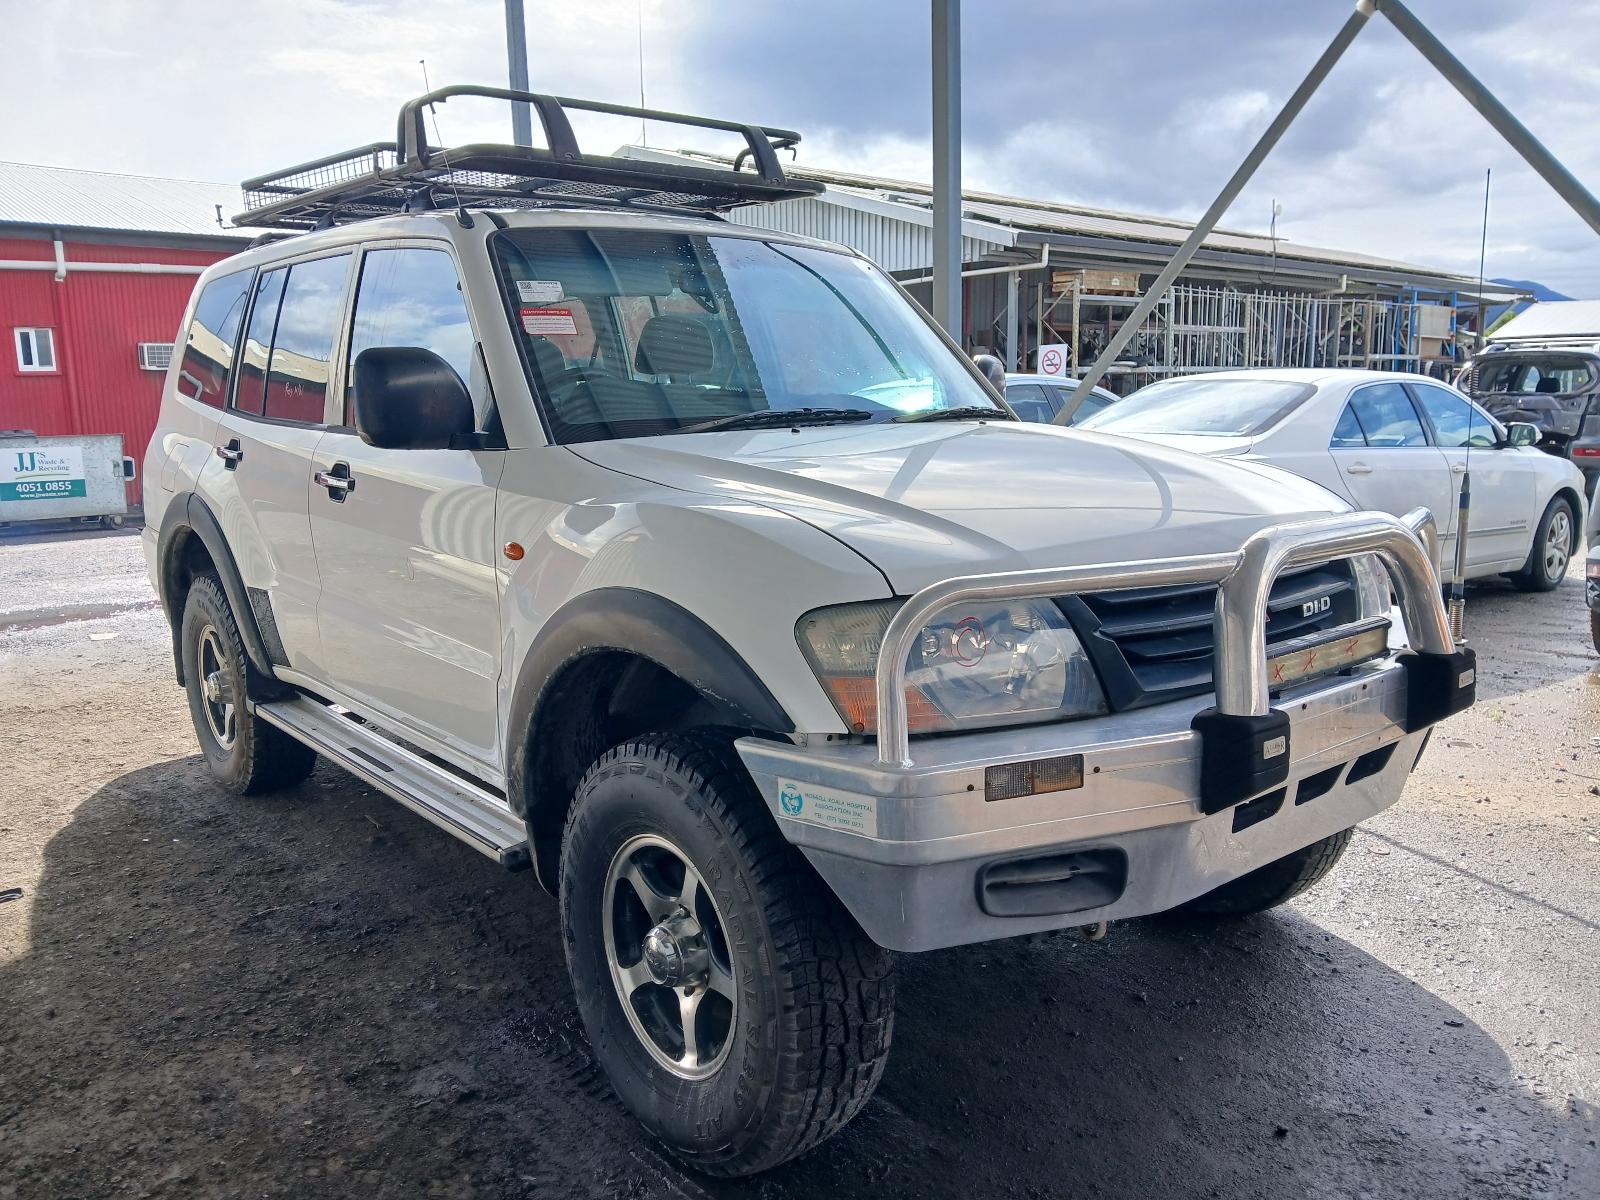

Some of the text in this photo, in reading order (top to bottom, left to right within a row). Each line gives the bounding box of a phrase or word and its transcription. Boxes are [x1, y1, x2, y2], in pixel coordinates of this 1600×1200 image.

[16, 481, 72, 492] 4051 0855
[814, 802, 849, 815] ASSOCIATION
[828, 796, 845, 805] KOALA
[846, 800, 873, 813] HOSPITAL
